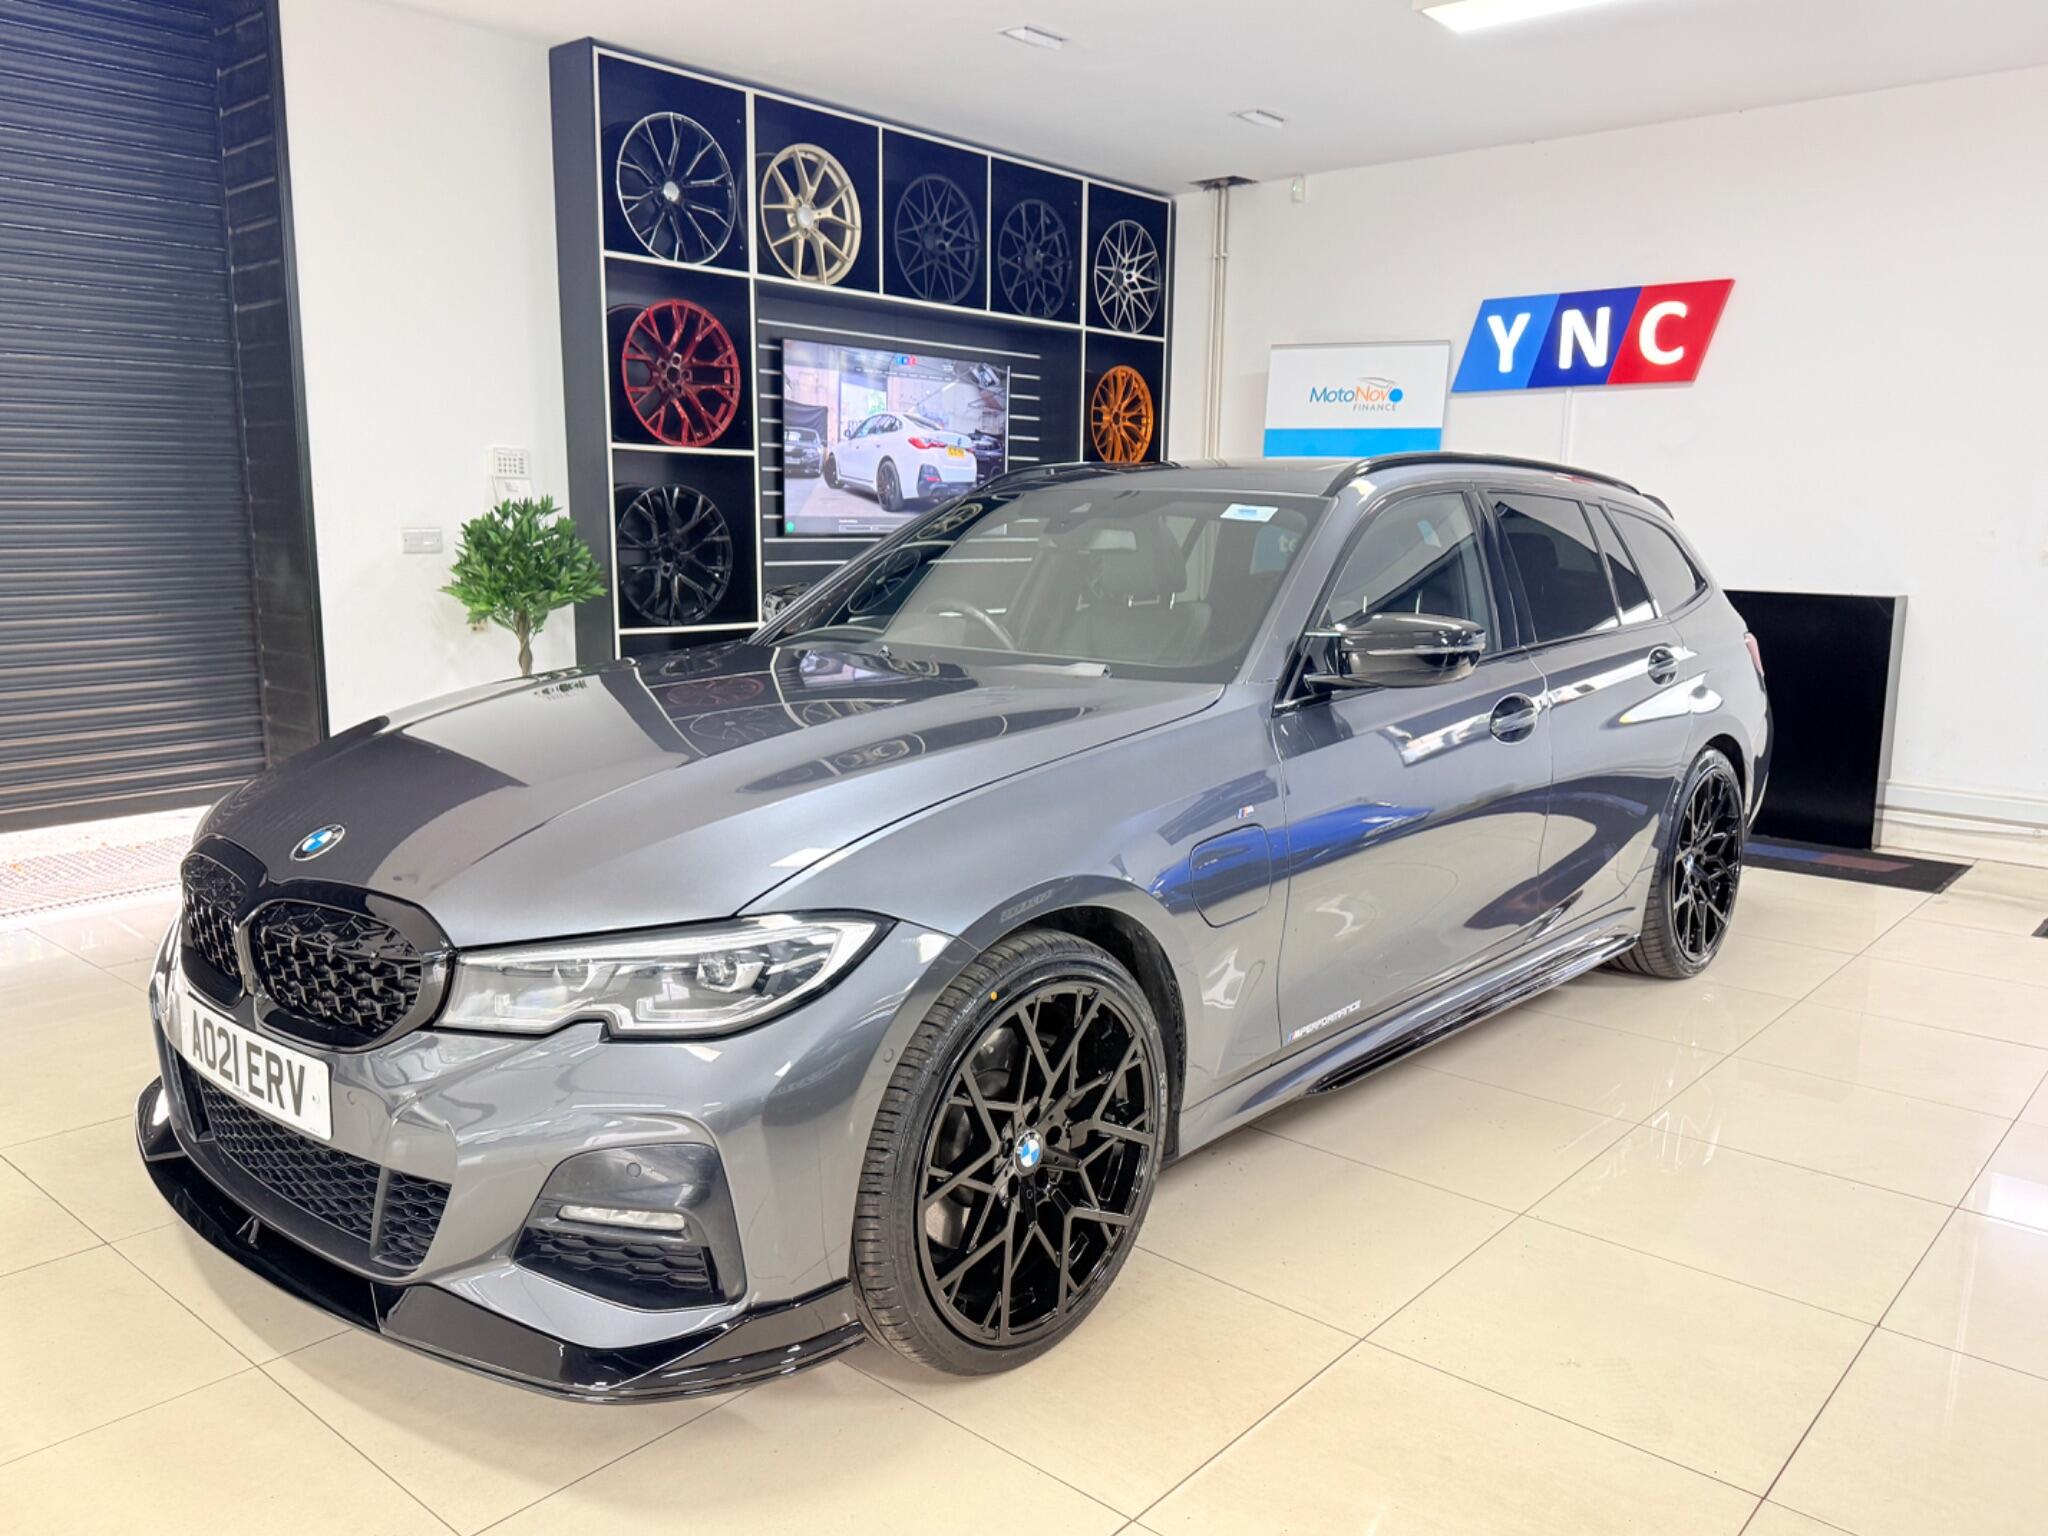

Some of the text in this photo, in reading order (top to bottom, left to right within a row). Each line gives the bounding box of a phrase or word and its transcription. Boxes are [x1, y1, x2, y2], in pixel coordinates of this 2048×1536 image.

[1487, 301, 1688, 373] YNC
[1352, 403, 1397, 412] FINANCE
[246, 1041, 305, 1117] ERV
